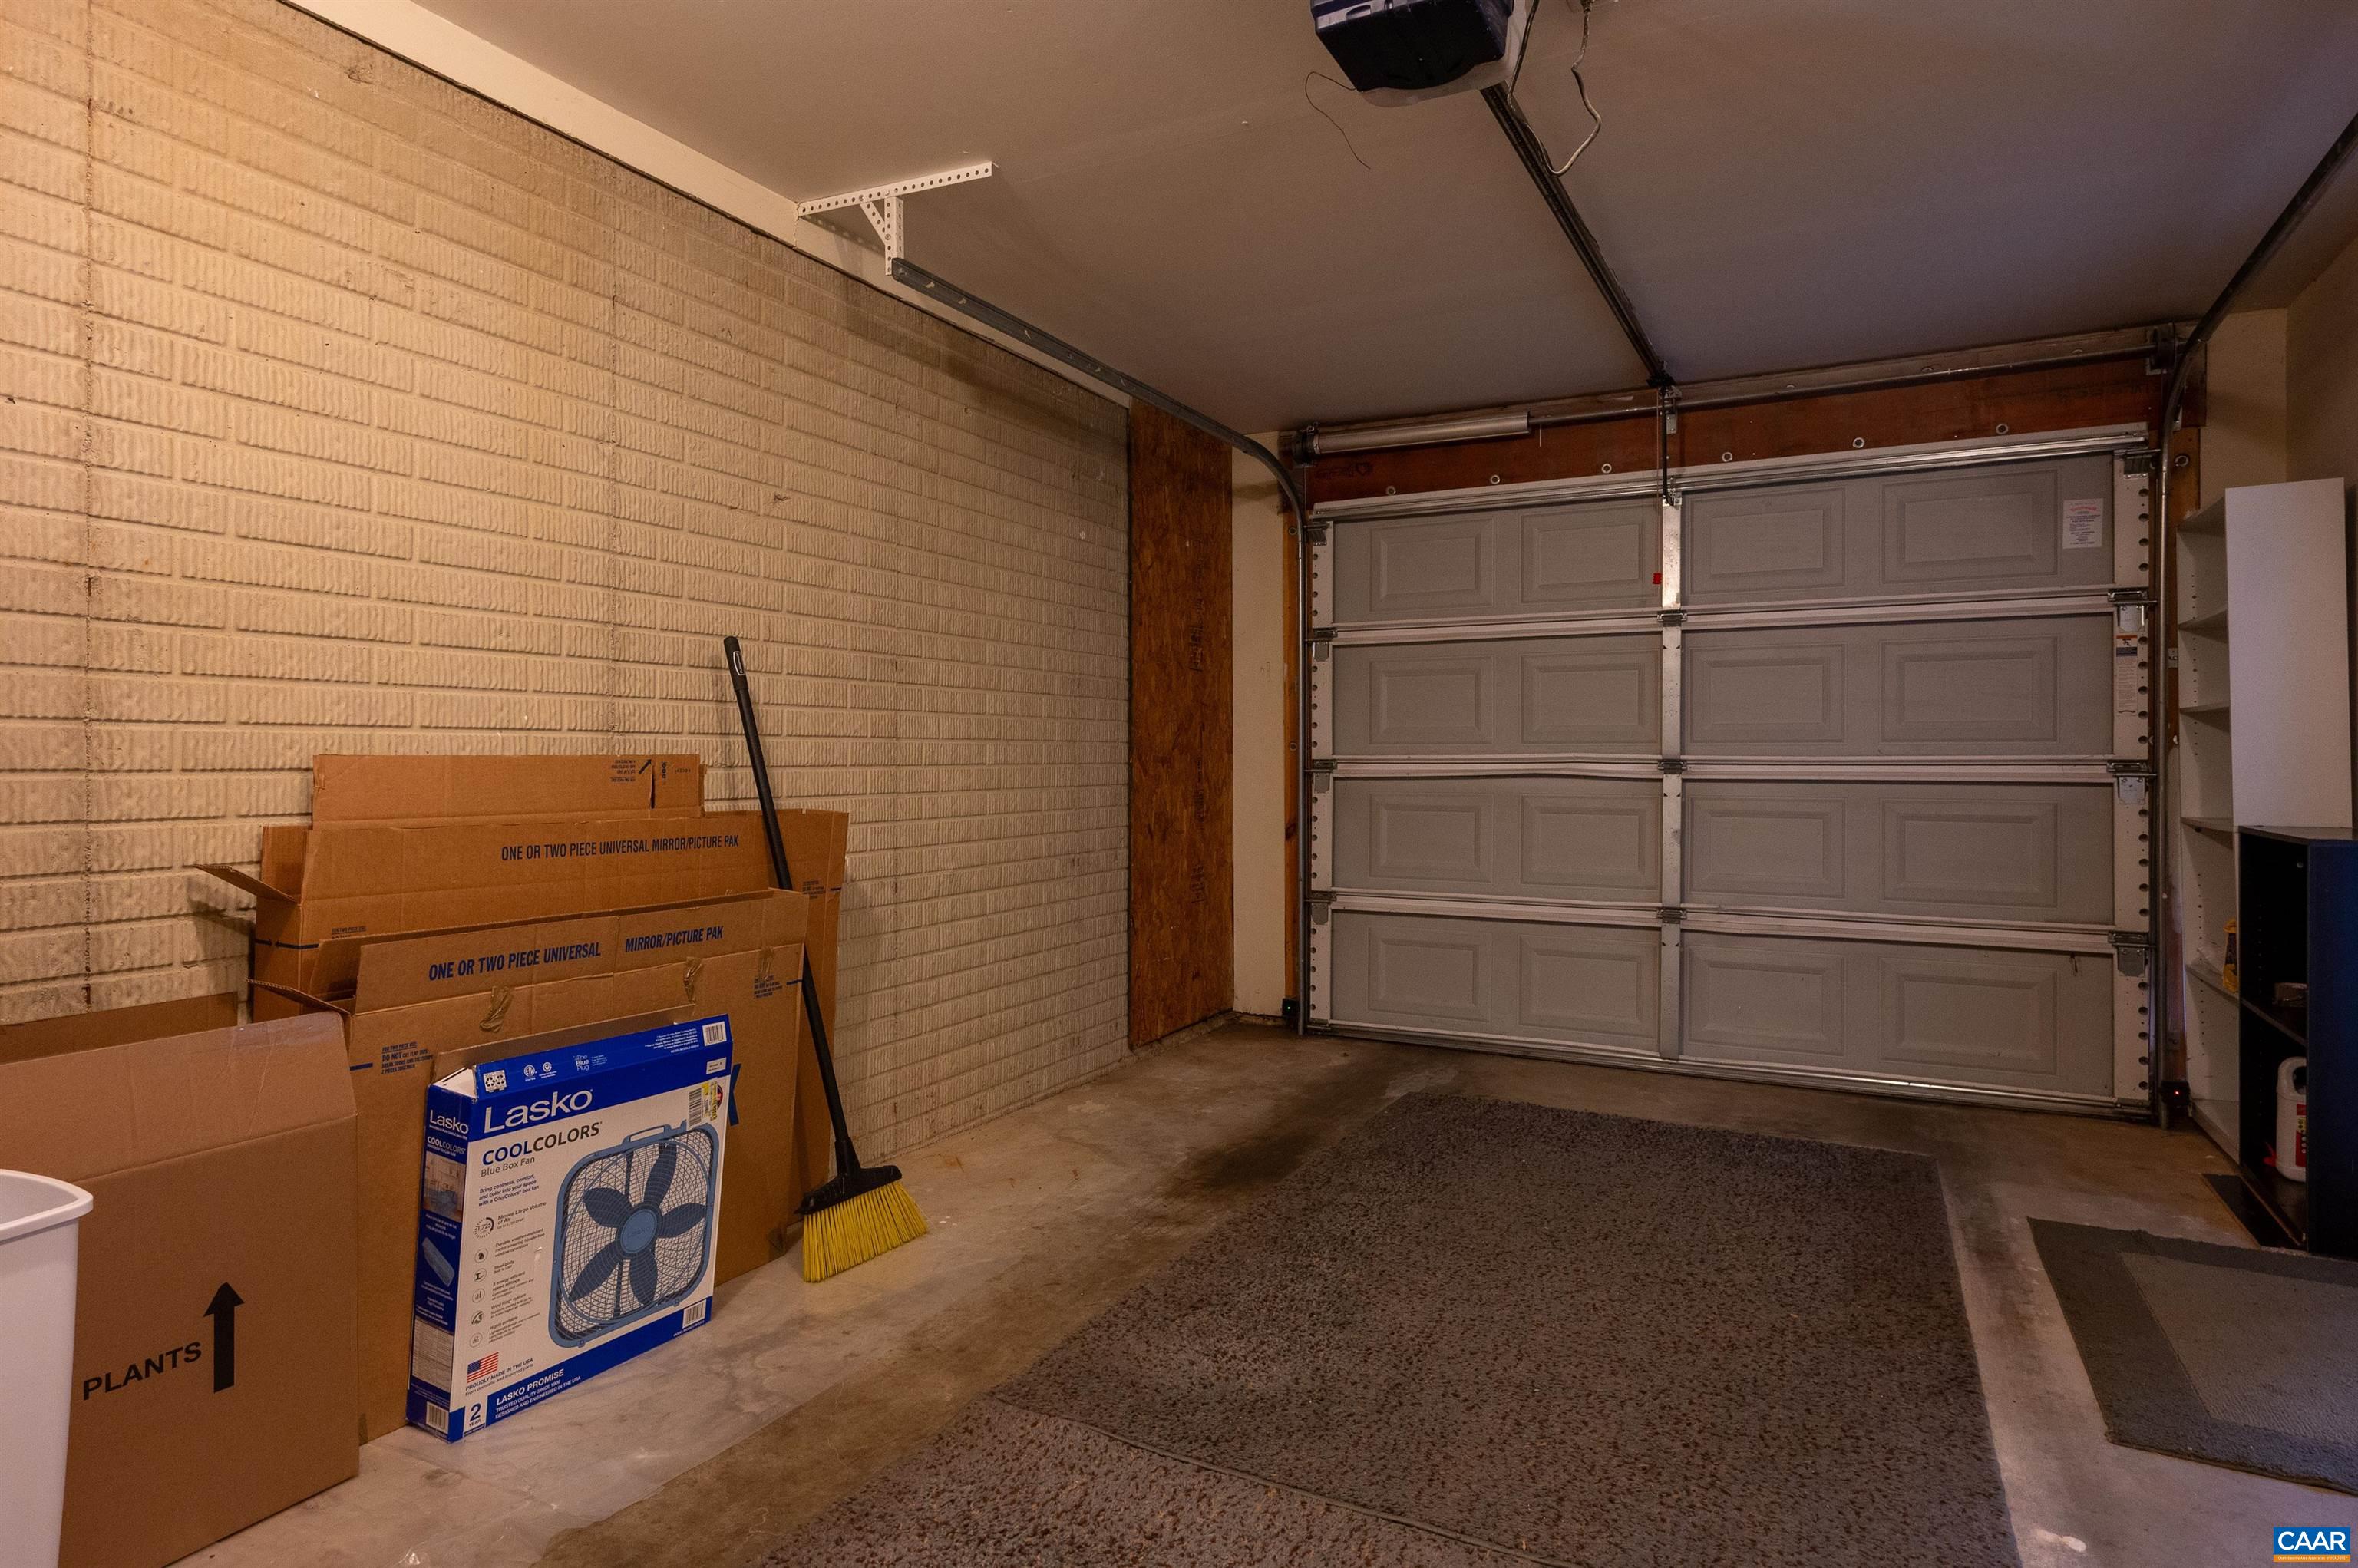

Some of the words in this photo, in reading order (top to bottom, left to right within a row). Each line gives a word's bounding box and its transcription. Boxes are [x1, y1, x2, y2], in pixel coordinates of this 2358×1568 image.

[502, 846, 522, 860] ONE
[527, 845, 540, 859] OR
[544, 843, 566, 858] TWO
[570, 842, 596, 856] PIECE
[599, 840, 649, 854] UNIVERSAL
[652, 836, 722, 852] MIRROR/PICTURE
[724, 835, 738, 847] PAK
[429, 962, 454, 981] ONE
[457, 959, 474, 975] OR
[478, 955, 504, 973] TWO
[508, 950, 540, 969] PIECE
[543, 942, 601, 962] UNIVERSAL
[625, 929, 703, 952] MIRROR/PICTURE
[706, 926, 723, 940] PAK
[430, 1110, 468, 1134] Lasko
[484, 1091, 593, 1133] Lasko
[428, 1137, 464, 1154] COOLCOLORS
[482, 1122, 599, 1165] COOLCOLORS
[481, 1167, 500, 1177] Blue
[503, 1161, 518, 1171] Box
[520, 1157, 535, 1166] Fan
[84, 1342, 202, 1400] PLANTS
[466, 1378, 490, 1391] PROUDLY
[491, 1371, 505, 1379] MADE
[496, 1398, 517, 1413] TRUSTED
[517, 1390, 537, 1403] QUALITY
[537, 1385, 550, 1393] SINCE
[497, 1387, 525, 1405] LASKO
[527, 1369, 564, 1391] PROMISE
[470, 1403, 481, 1422] 2
[495, 1406, 519, 1419] DESIGNED
